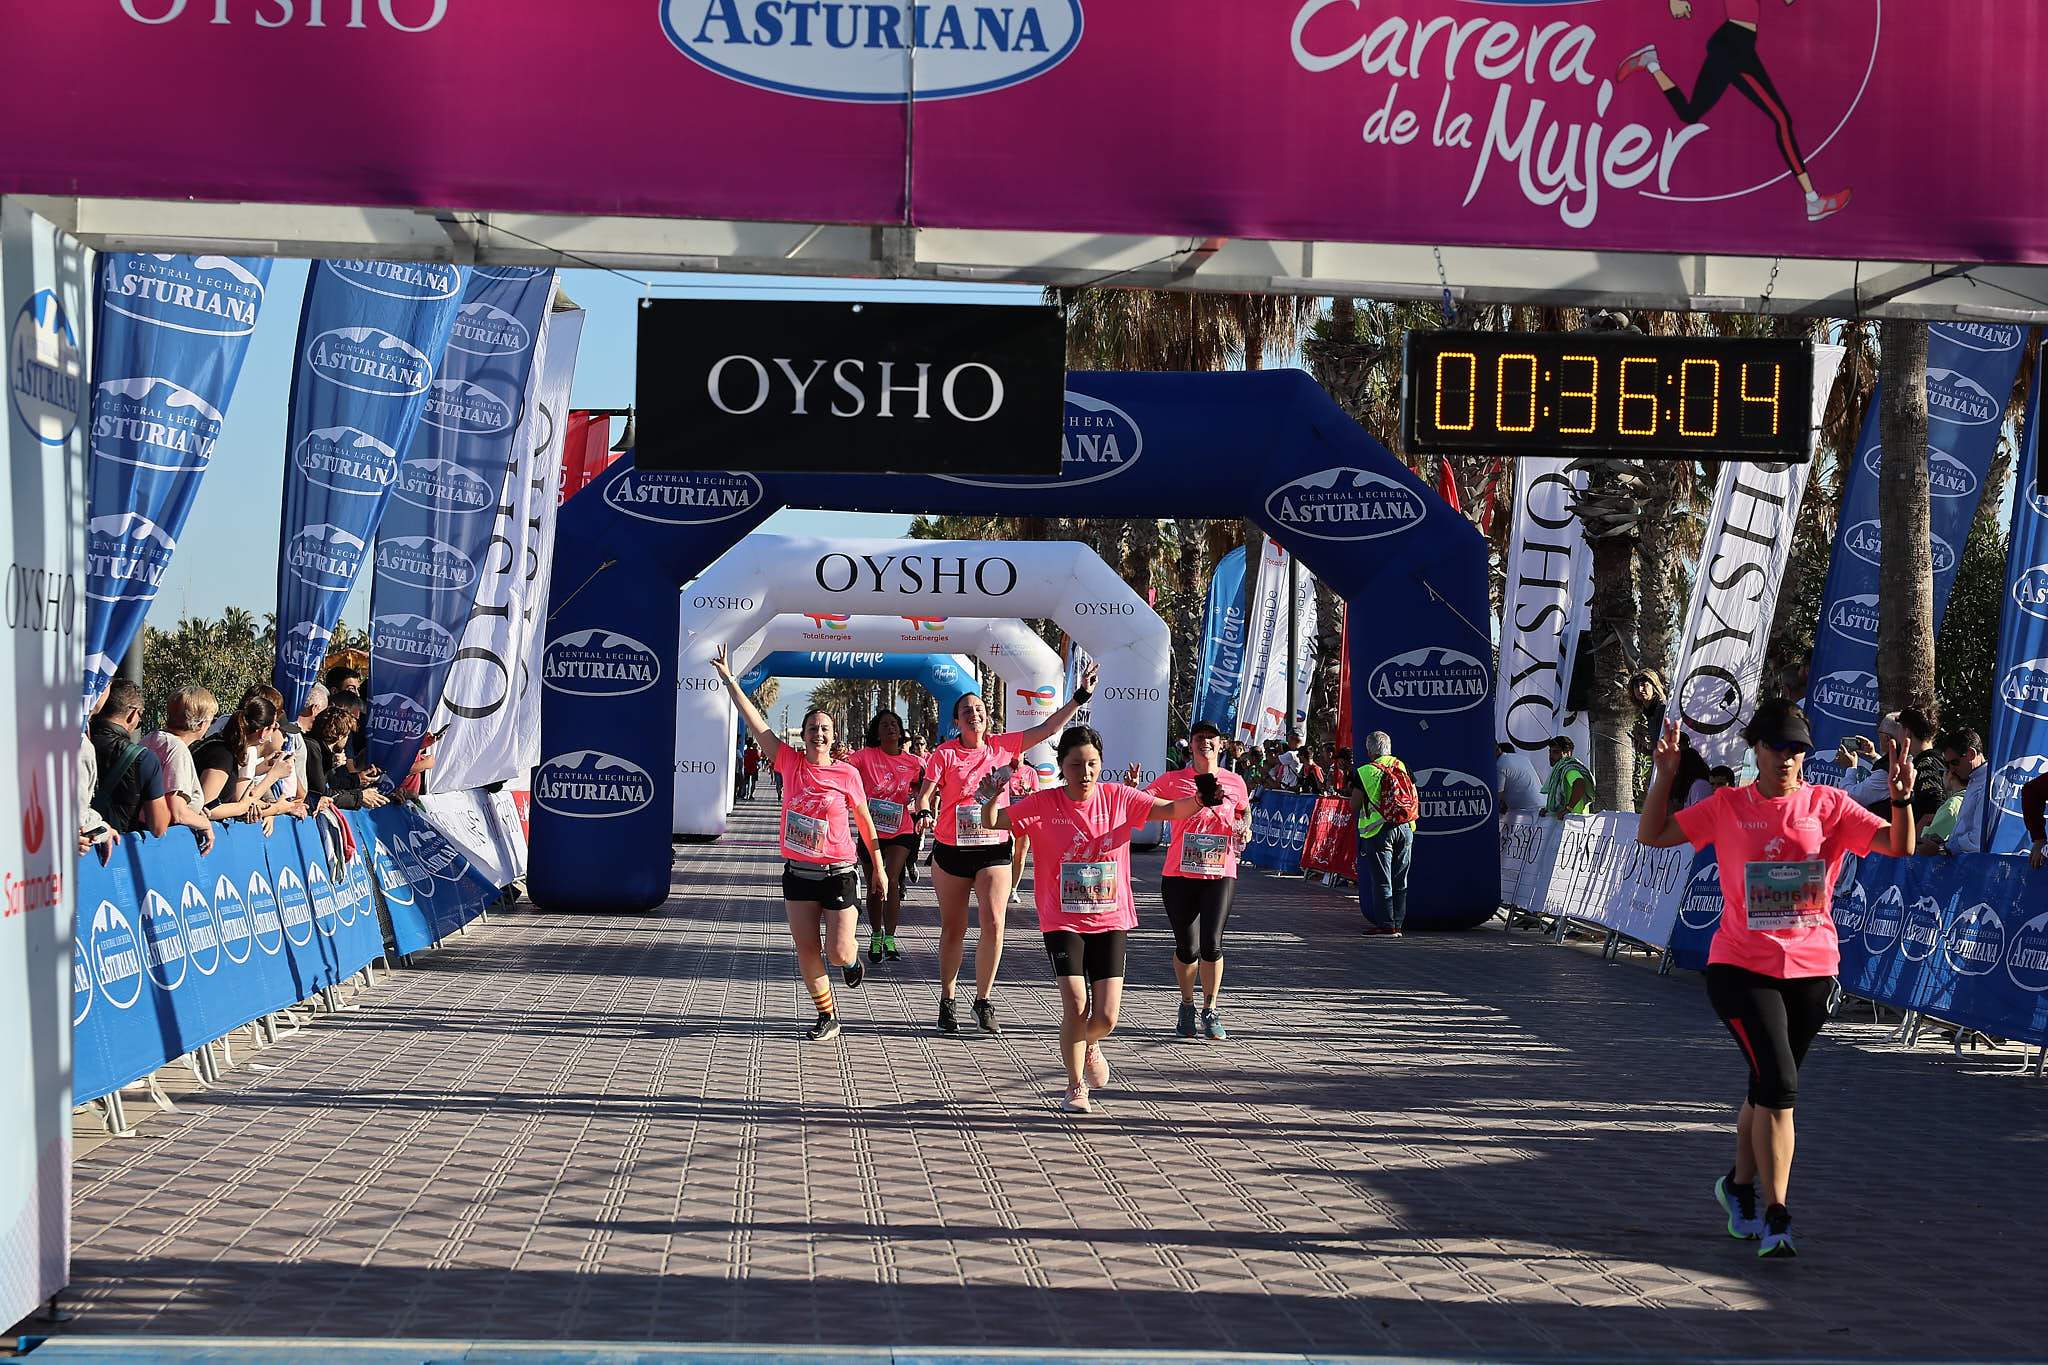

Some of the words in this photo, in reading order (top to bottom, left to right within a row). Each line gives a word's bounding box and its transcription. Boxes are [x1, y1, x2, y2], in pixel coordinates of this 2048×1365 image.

[692, 0, 1049, 52] ASTURIANA
[1289, 0, 1597, 85] Carrera
[1362, 93, 1419, 145] de
[1432, 84, 1473, 148] la
[1463, 78, 1711, 229] Mujer
[105, 259, 256, 326] ASTURIANA
[128, 260, 191, 281] CENTRAL
[197, 275, 257, 299] LECHERA
[452, 322, 521, 349] TURIANA
[314, 342, 423, 389] ASTURIANA
[334, 342, 376, 357] CENTRAL
[380, 349, 424, 369] LECHERA
[706, 354, 1005, 423] OYSHO
[1434, 351, 1780, 437] 00:36:04
[103, 401, 163, 419] CENTRAL
[424, 398, 502, 427] STURIANA
[1926, 388, 1989, 420] TURIANA
[1068, 416, 1115, 428] HERA
[314, 443, 350, 457] CENRAL
[302, 444, 389, 487] ASTURIAN
[396, 470, 485, 507] ASTURIANA
[613, 478, 751, 508] ASTURIANA
[640, 474, 690, 485] CENTRAL
[695, 476, 749, 487] LECHERA
[1279, 496, 1417, 523] ASTURIANA
[1300, 491, 1353, 501] CENTRAL
[1358, 490, 1409, 500] LECHERA
[377, 547, 468, 584] ASTURIANA
[815, 553, 1018, 597] OYSHO
[6, 563, 75, 635] OYSHO
[693, 596, 754, 611] OYSHO
[1074, 602, 1135, 617] OYSHO
[1505, 472, 1579, 751] OYSHO
[1850, 607, 1880, 617] CENTRA
[372, 634, 449, 659] STURIANA
[802, 633, 851, 642] TotalEnergies
[901, 634, 949, 643] TotalEnergies
[543, 653, 652, 682] ASTURIANA
[559, 651, 601, 661] CENTRAL
[606, 652, 650, 662] LECHERA
[676, 677, 720, 692] YSHO
[1376, 672, 1484, 698] ASTURIANA
[1395, 669, 1440, 678] CENTRAL
[1444, 669, 1482, 677] LECHERA
[1104, 687, 1160, 702] OYSHO
[1815, 684, 1880, 713] ASTURIA
[553, 772, 594, 781] CENTRAL
[598, 774, 643, 783] LECHERA
[673, 760, 717, 774] YSHO
[538, 773, 646, 802] ASTURIANA
[1419, 798, 1488, 818] URIANA
[1946, 927, 1999, 963] ASTURIANA
[2010, 937, 2048, 971] ASTURI
[97, 943, 140, 985] ASTURIANA
